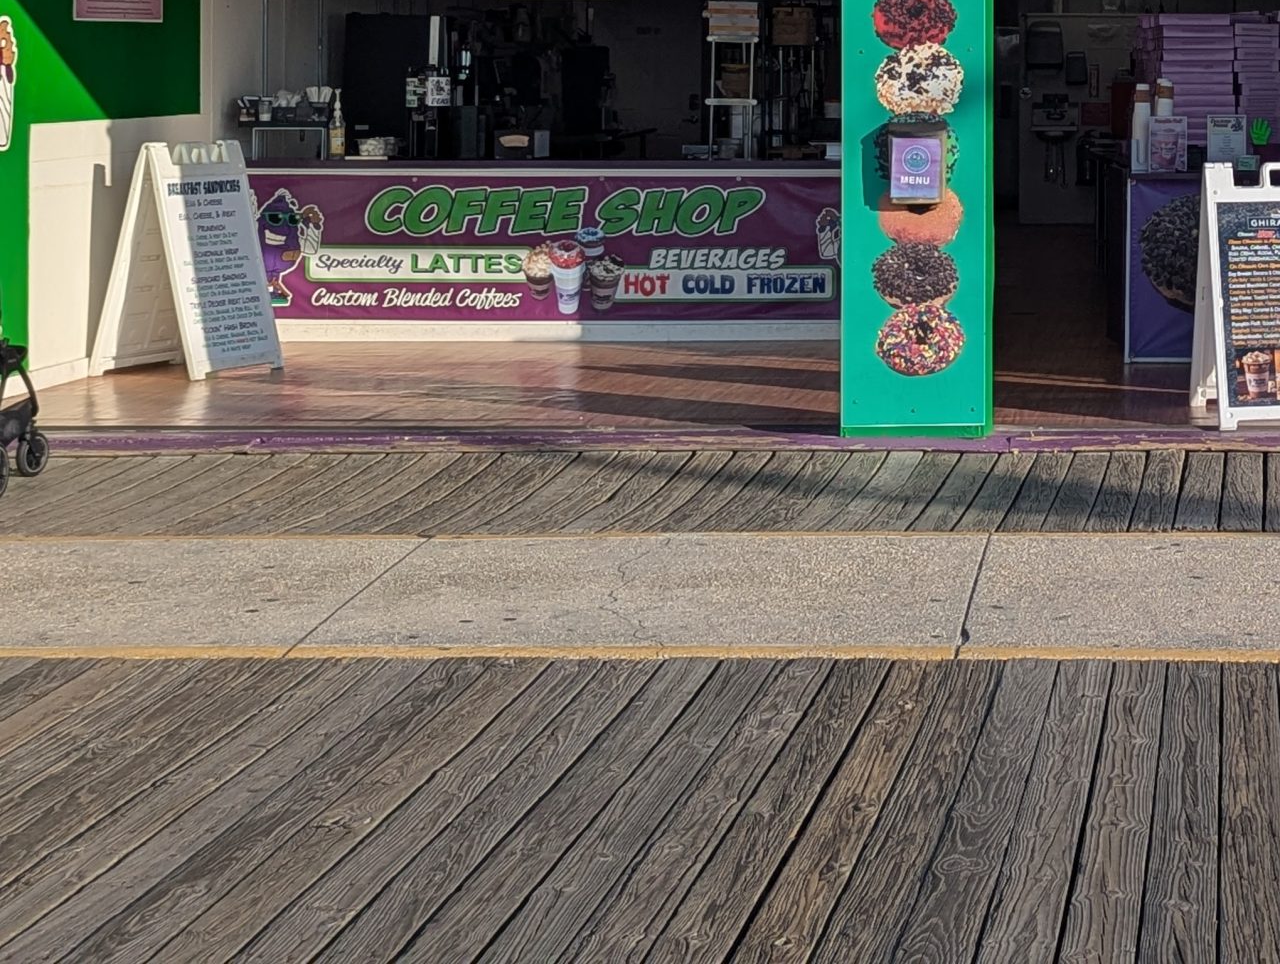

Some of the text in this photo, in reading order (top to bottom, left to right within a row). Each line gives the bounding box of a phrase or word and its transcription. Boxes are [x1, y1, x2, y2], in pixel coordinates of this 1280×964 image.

[900, 175, 930, 185] MENU
[365, 185, 766, 237] COFFEE SHOP
[316, 252, 522, 274] Specialty LATTES
[649, 247, 787, 270] BEVERAGES
[623, 272, 826, 297] HOT COLD FROZEN
[311, 288, 522, 310] Custom Blended Coffees
